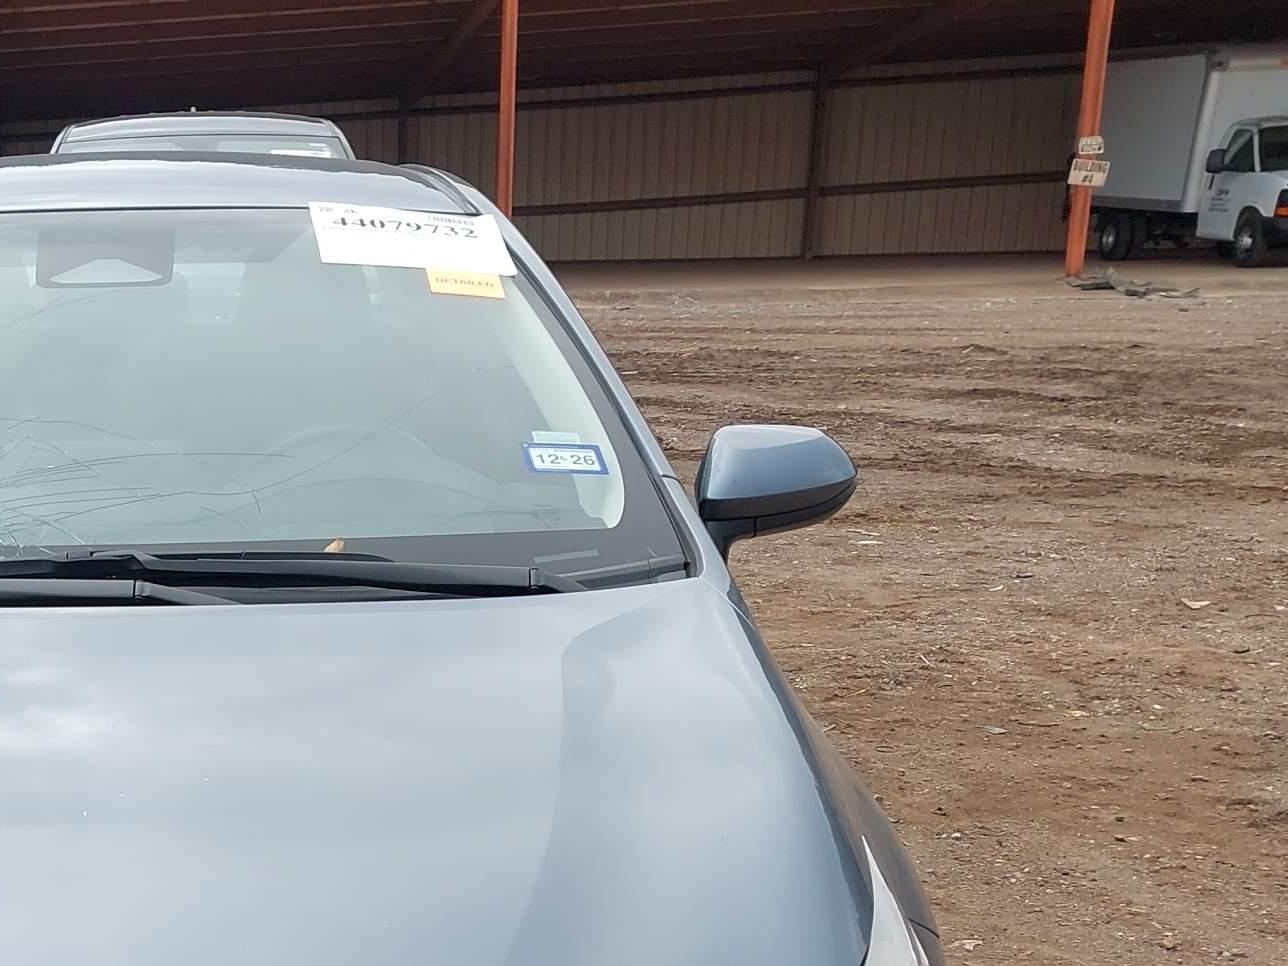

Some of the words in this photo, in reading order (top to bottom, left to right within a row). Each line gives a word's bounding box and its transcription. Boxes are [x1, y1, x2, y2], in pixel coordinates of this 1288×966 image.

[1073, 160, 1108, 174] BUILDING
[332, 216, 478, 238] 44079732
[435, 276, 495, 288] DETAILED
